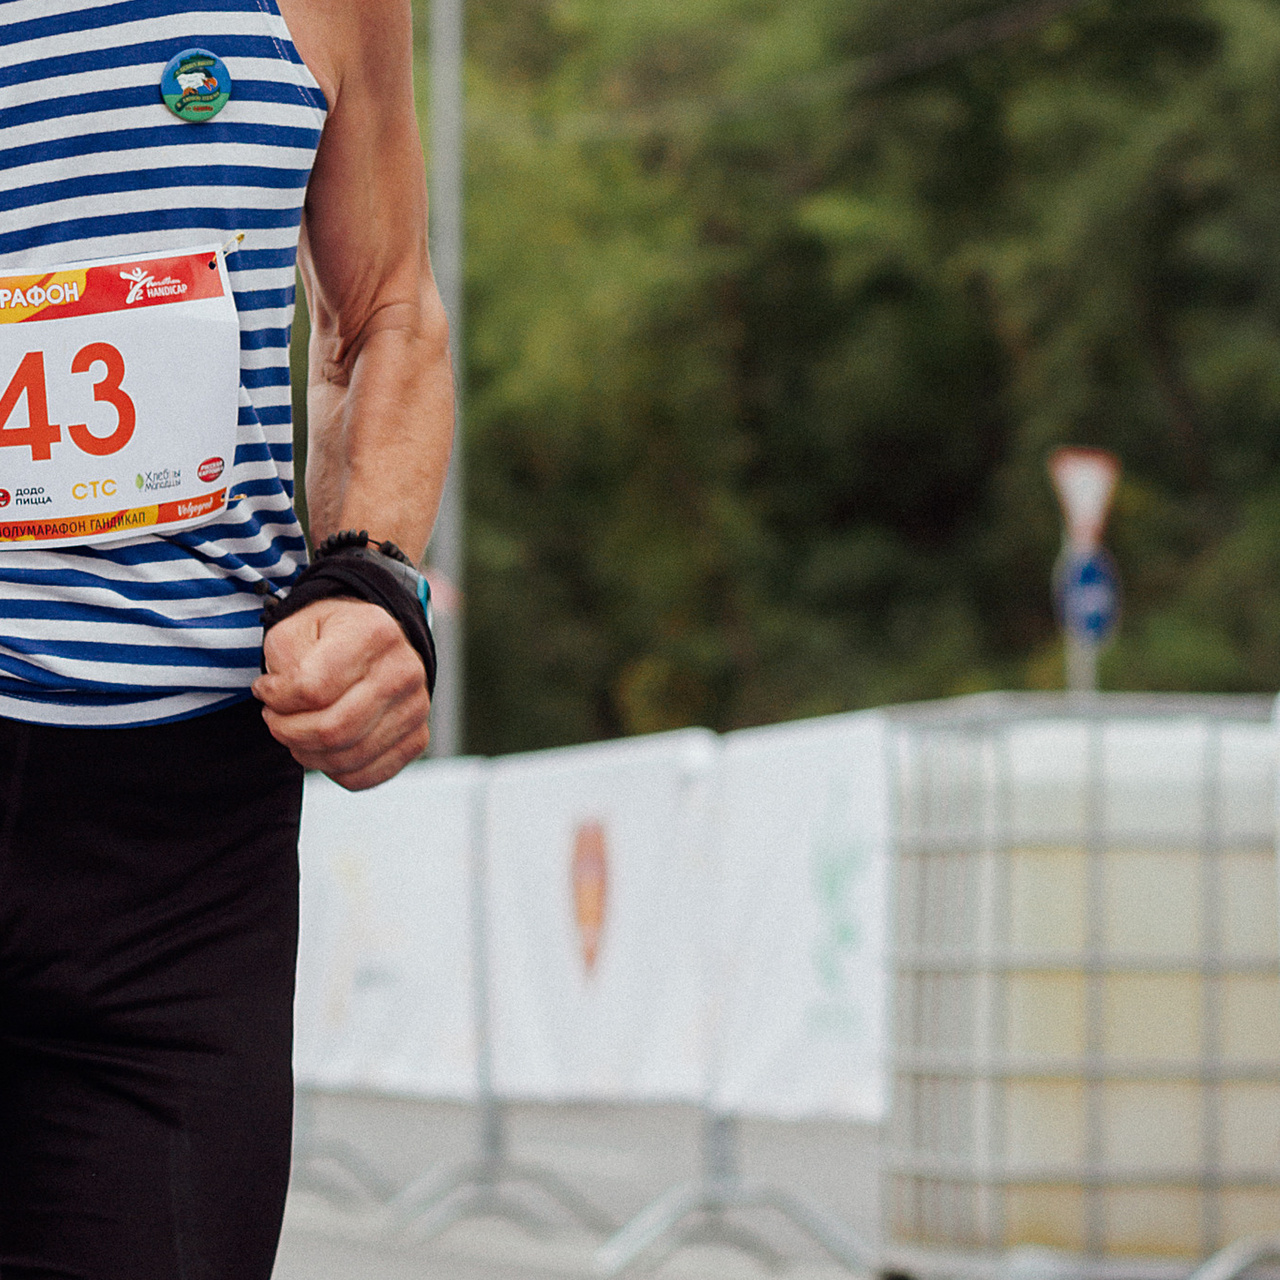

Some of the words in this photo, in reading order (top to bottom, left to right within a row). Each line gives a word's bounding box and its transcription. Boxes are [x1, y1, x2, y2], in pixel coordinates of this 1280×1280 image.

[147, 284, 188, 298] HANDICAP
[15, 487, 45, 496] ДОДО
[72, 479, 117, 500] СТС
[15, 496, 52, 505] ПИЦЦА
[90, 512, 146, 531] ГАНДИКАП
